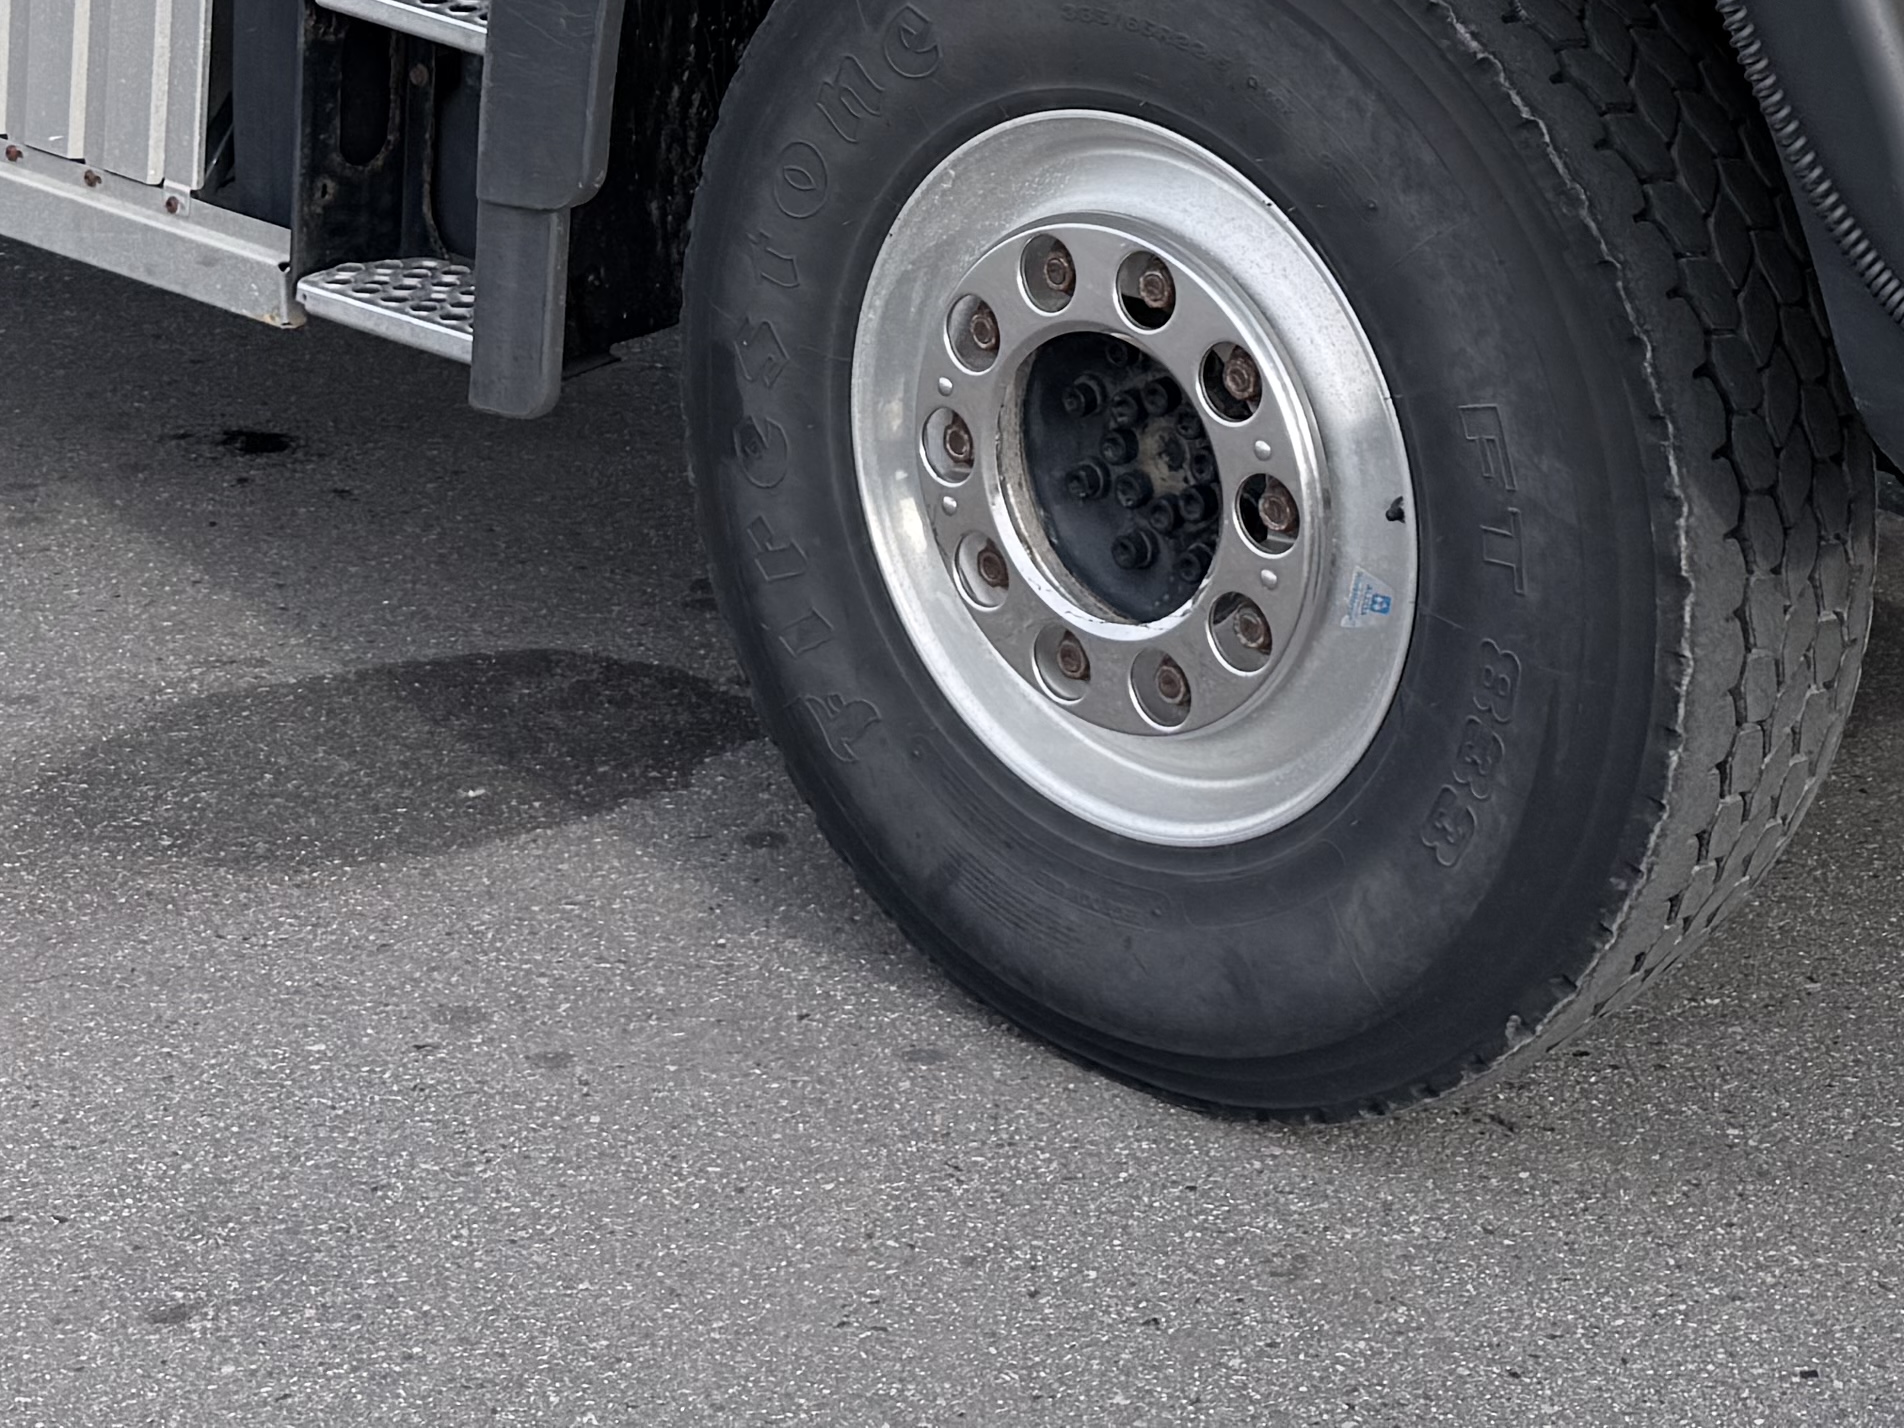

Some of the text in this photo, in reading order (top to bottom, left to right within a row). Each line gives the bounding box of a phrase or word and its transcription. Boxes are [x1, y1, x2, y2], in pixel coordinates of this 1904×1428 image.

[732, 3, 943, 762] Firestone
[1421, 403, 1526, 867] FT 833
